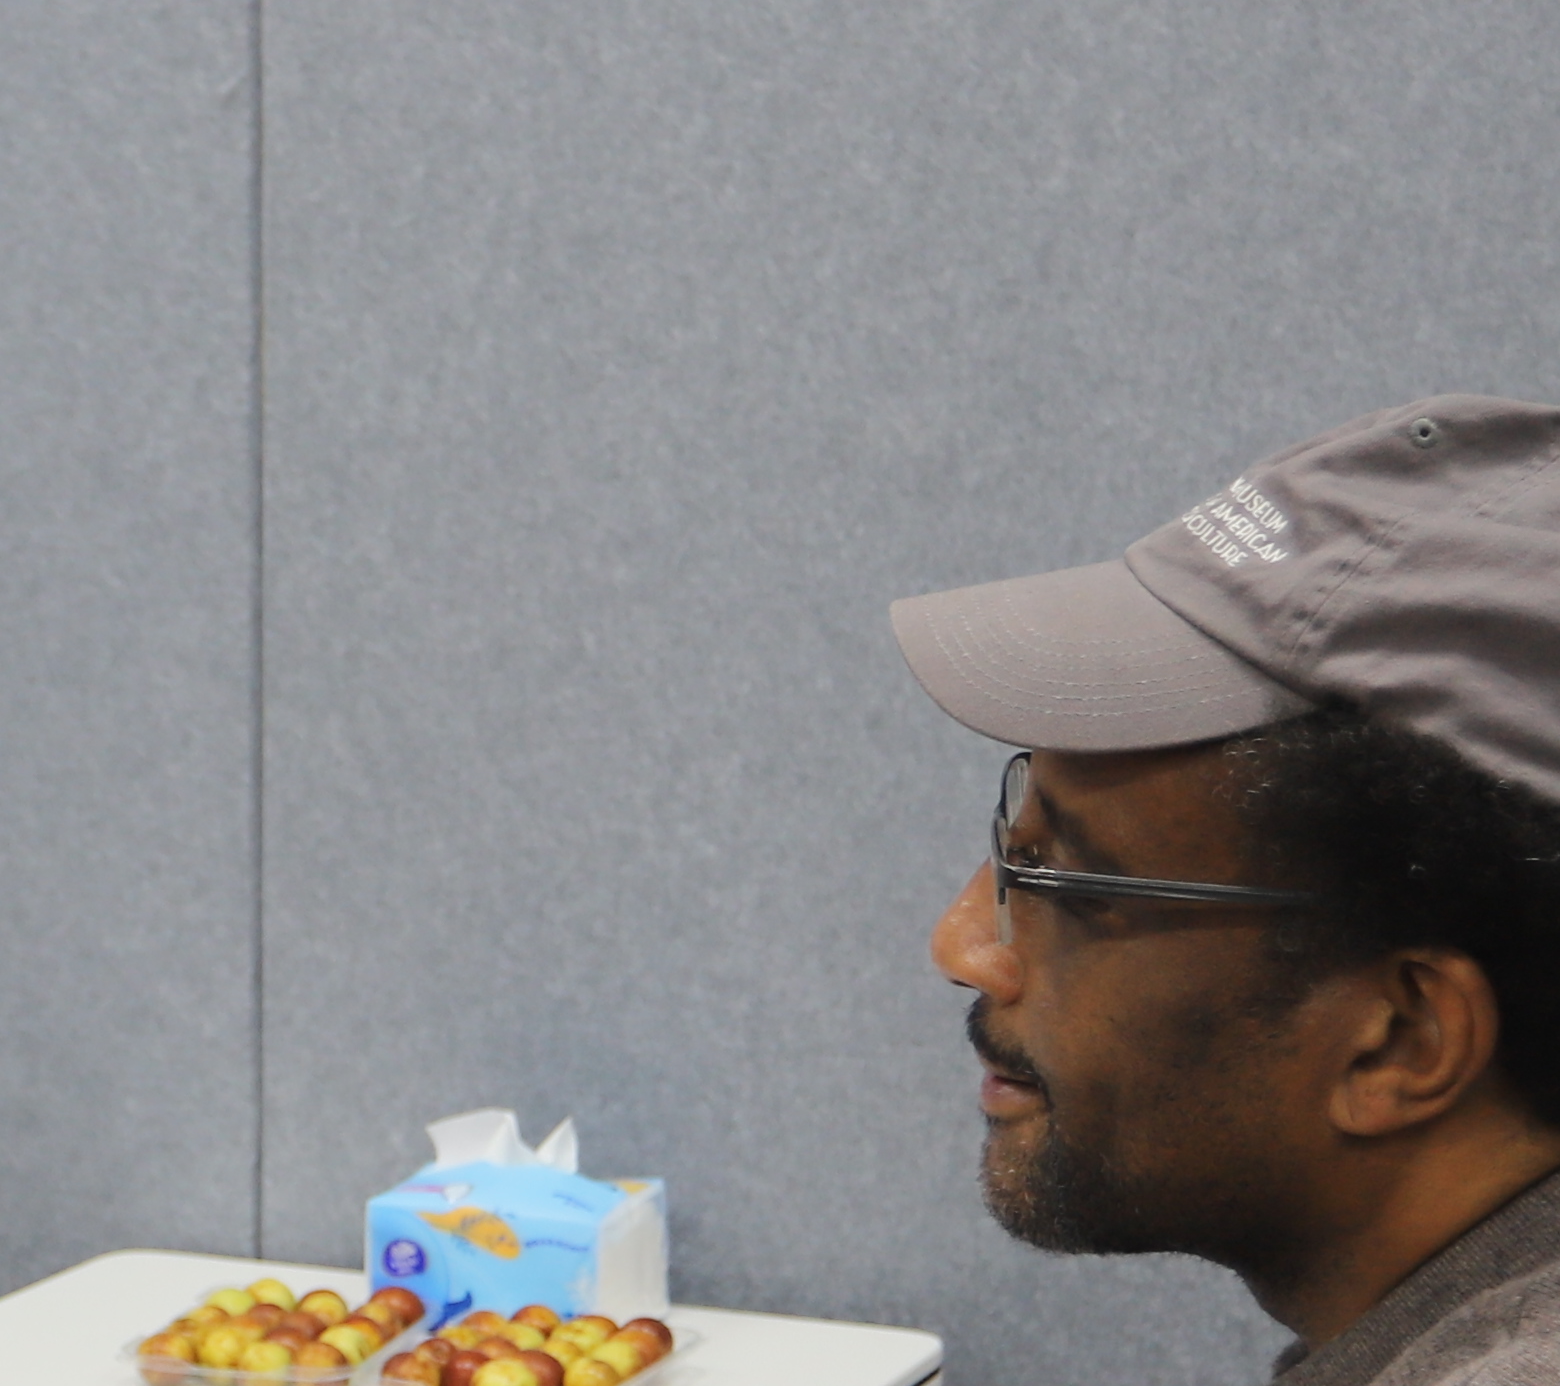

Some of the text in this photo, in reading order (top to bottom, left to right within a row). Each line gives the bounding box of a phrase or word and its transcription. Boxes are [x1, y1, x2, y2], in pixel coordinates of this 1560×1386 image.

[1210, 502, 1289, 563] AMERICAN
[1229, 477, 1288, 534] MUSEUM
[1186, 514, 1249, 567] CULTURE
